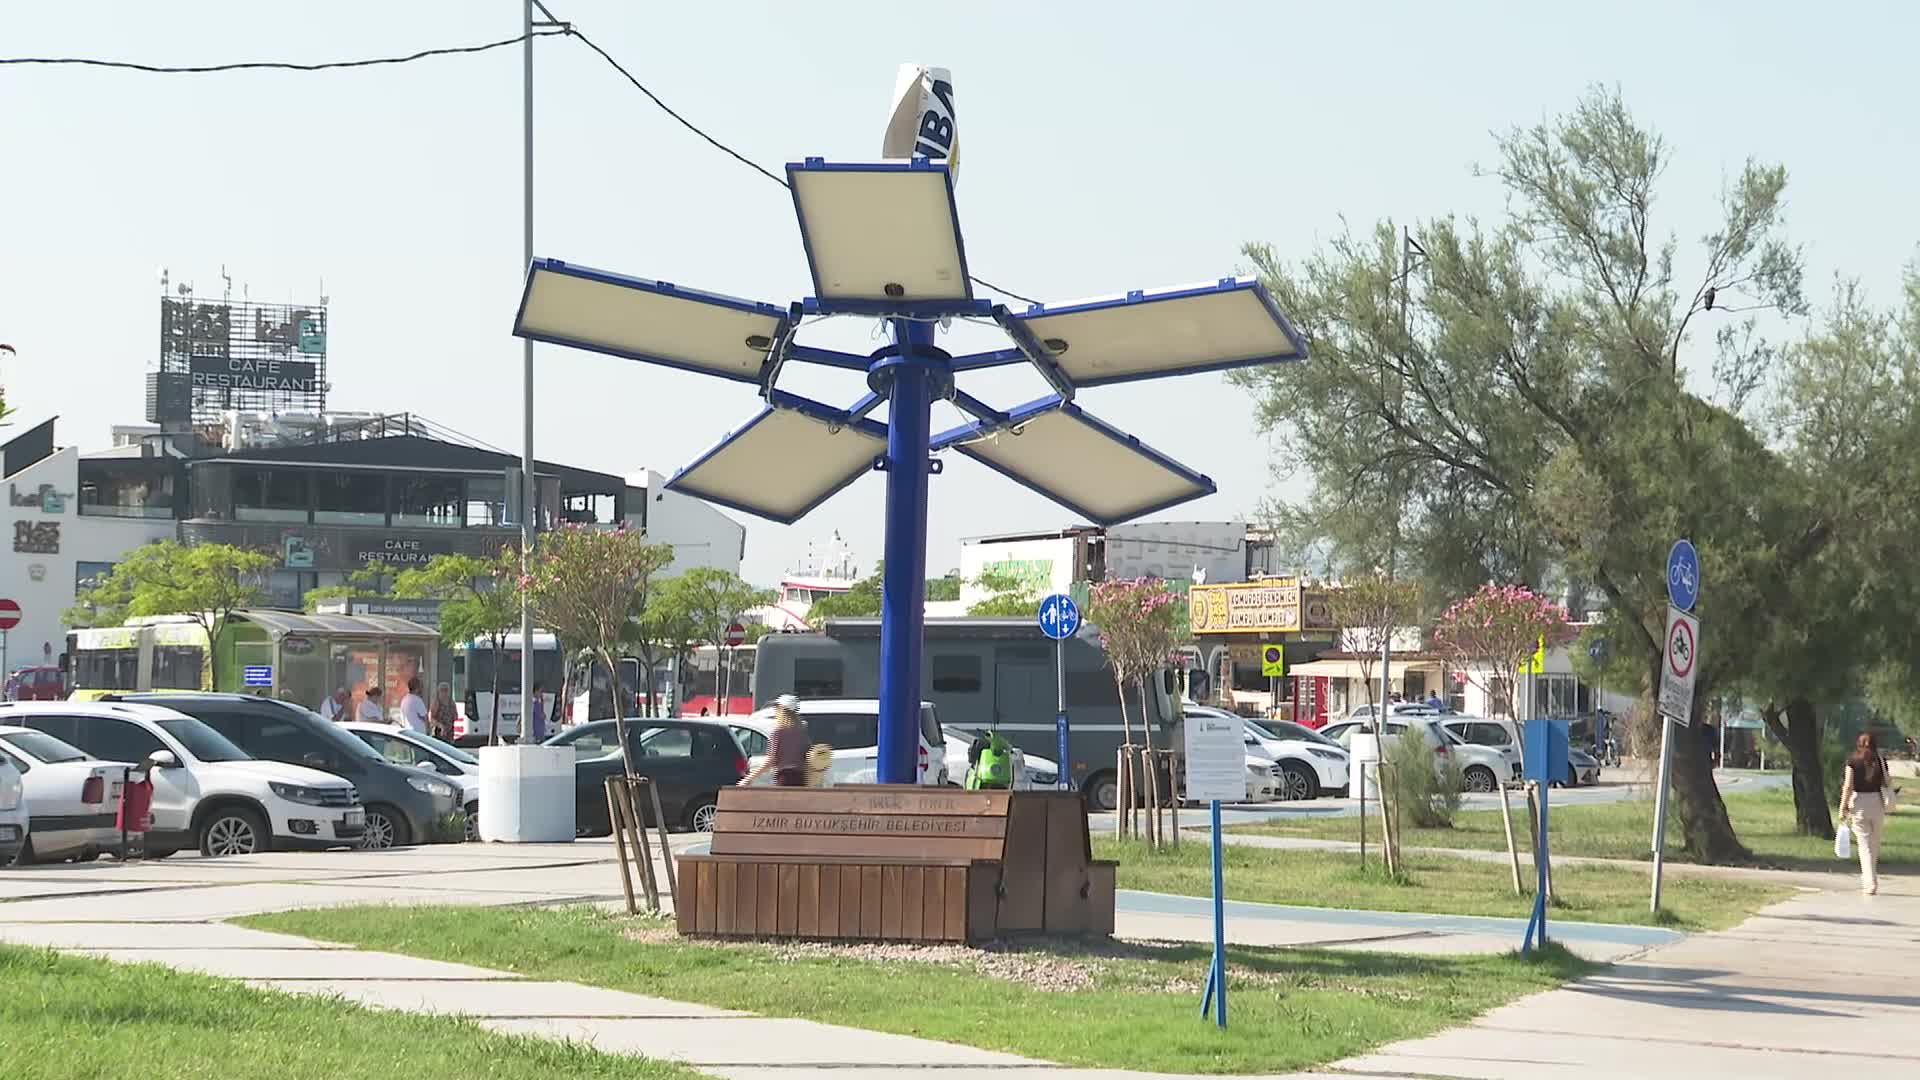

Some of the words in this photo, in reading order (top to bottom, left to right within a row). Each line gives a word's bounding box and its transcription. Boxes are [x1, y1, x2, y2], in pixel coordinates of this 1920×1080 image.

[228, 359, 281, 373] CAFE
[192, 373, 315, 390] RESTAURANT
[384, 540, 421, 550] CAFE
